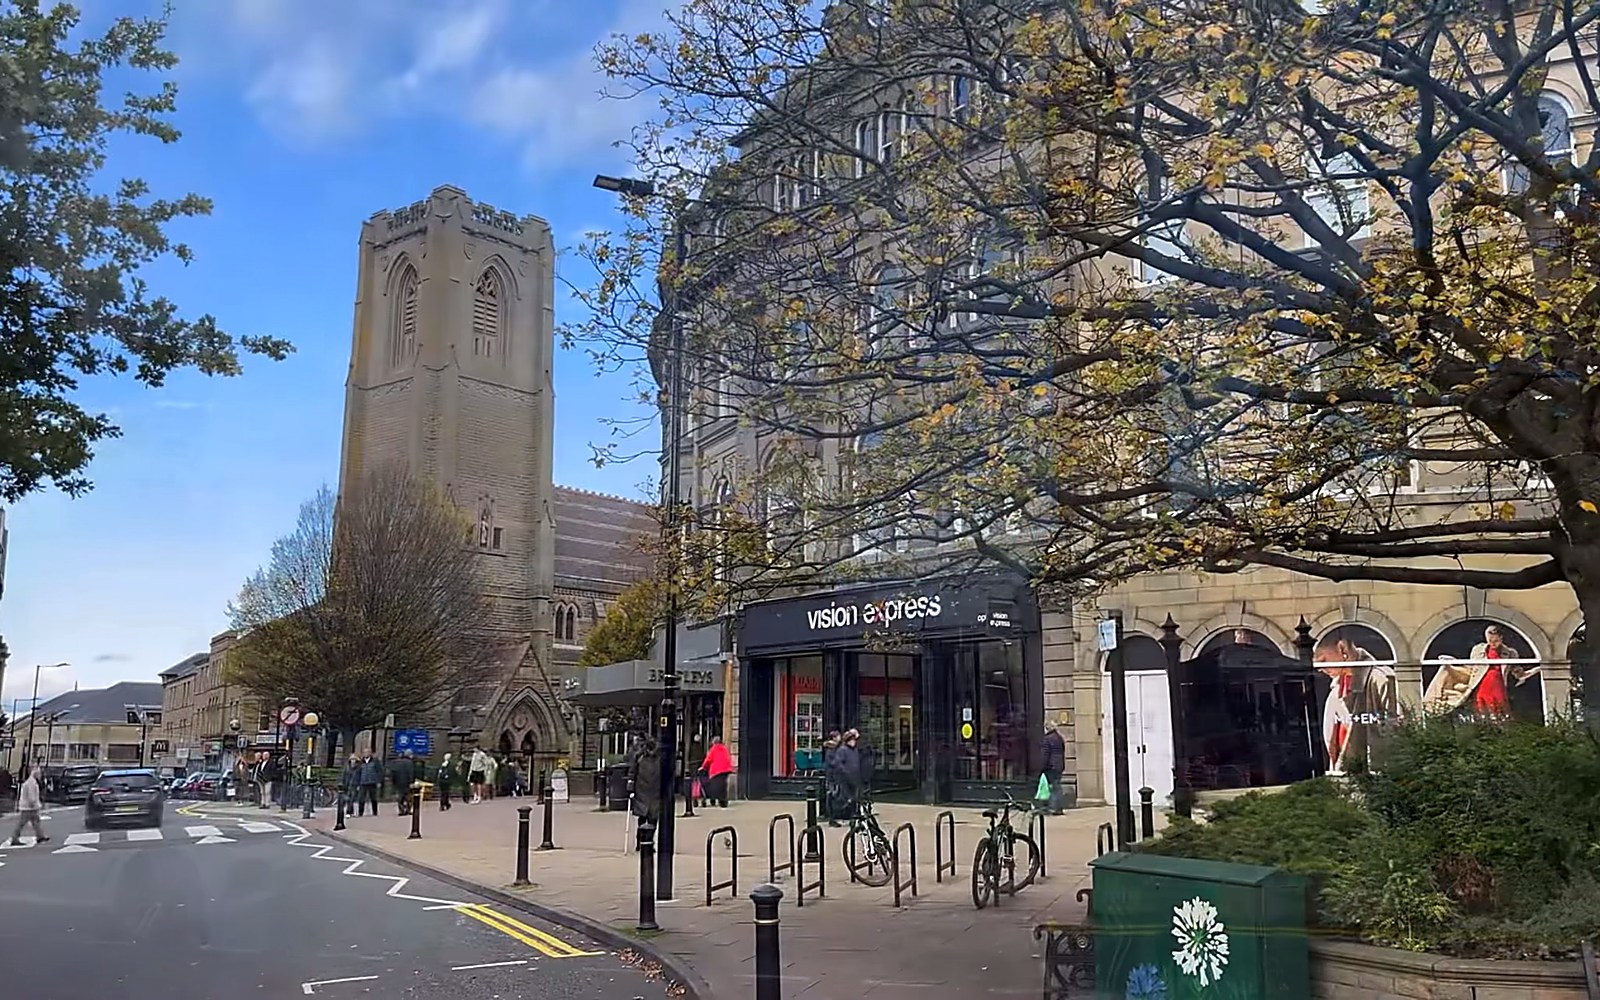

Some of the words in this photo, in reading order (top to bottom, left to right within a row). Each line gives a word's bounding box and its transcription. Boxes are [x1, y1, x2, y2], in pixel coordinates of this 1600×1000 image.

[807, 601, 858, 629] vision
[863, 595, 941, 628] express
[648, 669, 712, 684] BRDLEYS
